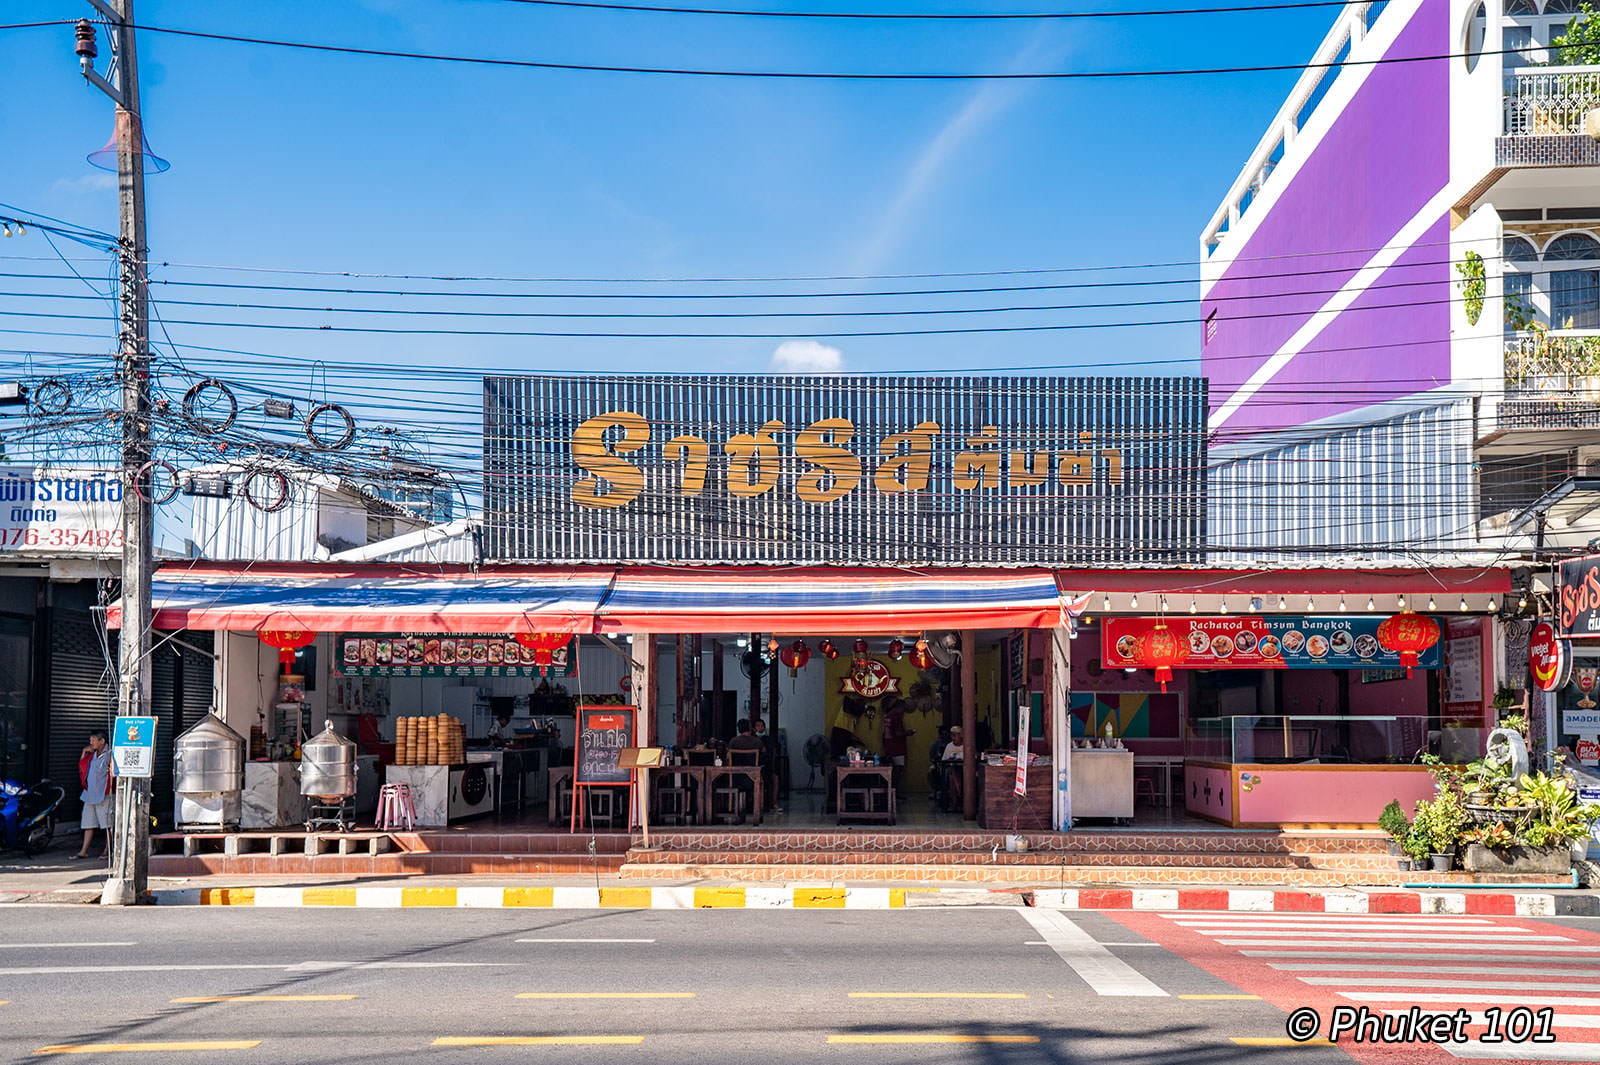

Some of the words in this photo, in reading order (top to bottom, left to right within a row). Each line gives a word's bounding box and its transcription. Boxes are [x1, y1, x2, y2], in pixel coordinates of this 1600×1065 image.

[571, 410, 940, 509] ราชรส
[10, 506, 57, 522] ติดต่อ
[1189, 620, 1243, 631] Racharod
[1250, 620, 1295, 629] Timsum
[1302, 620, 1352, 631] Bangkok
